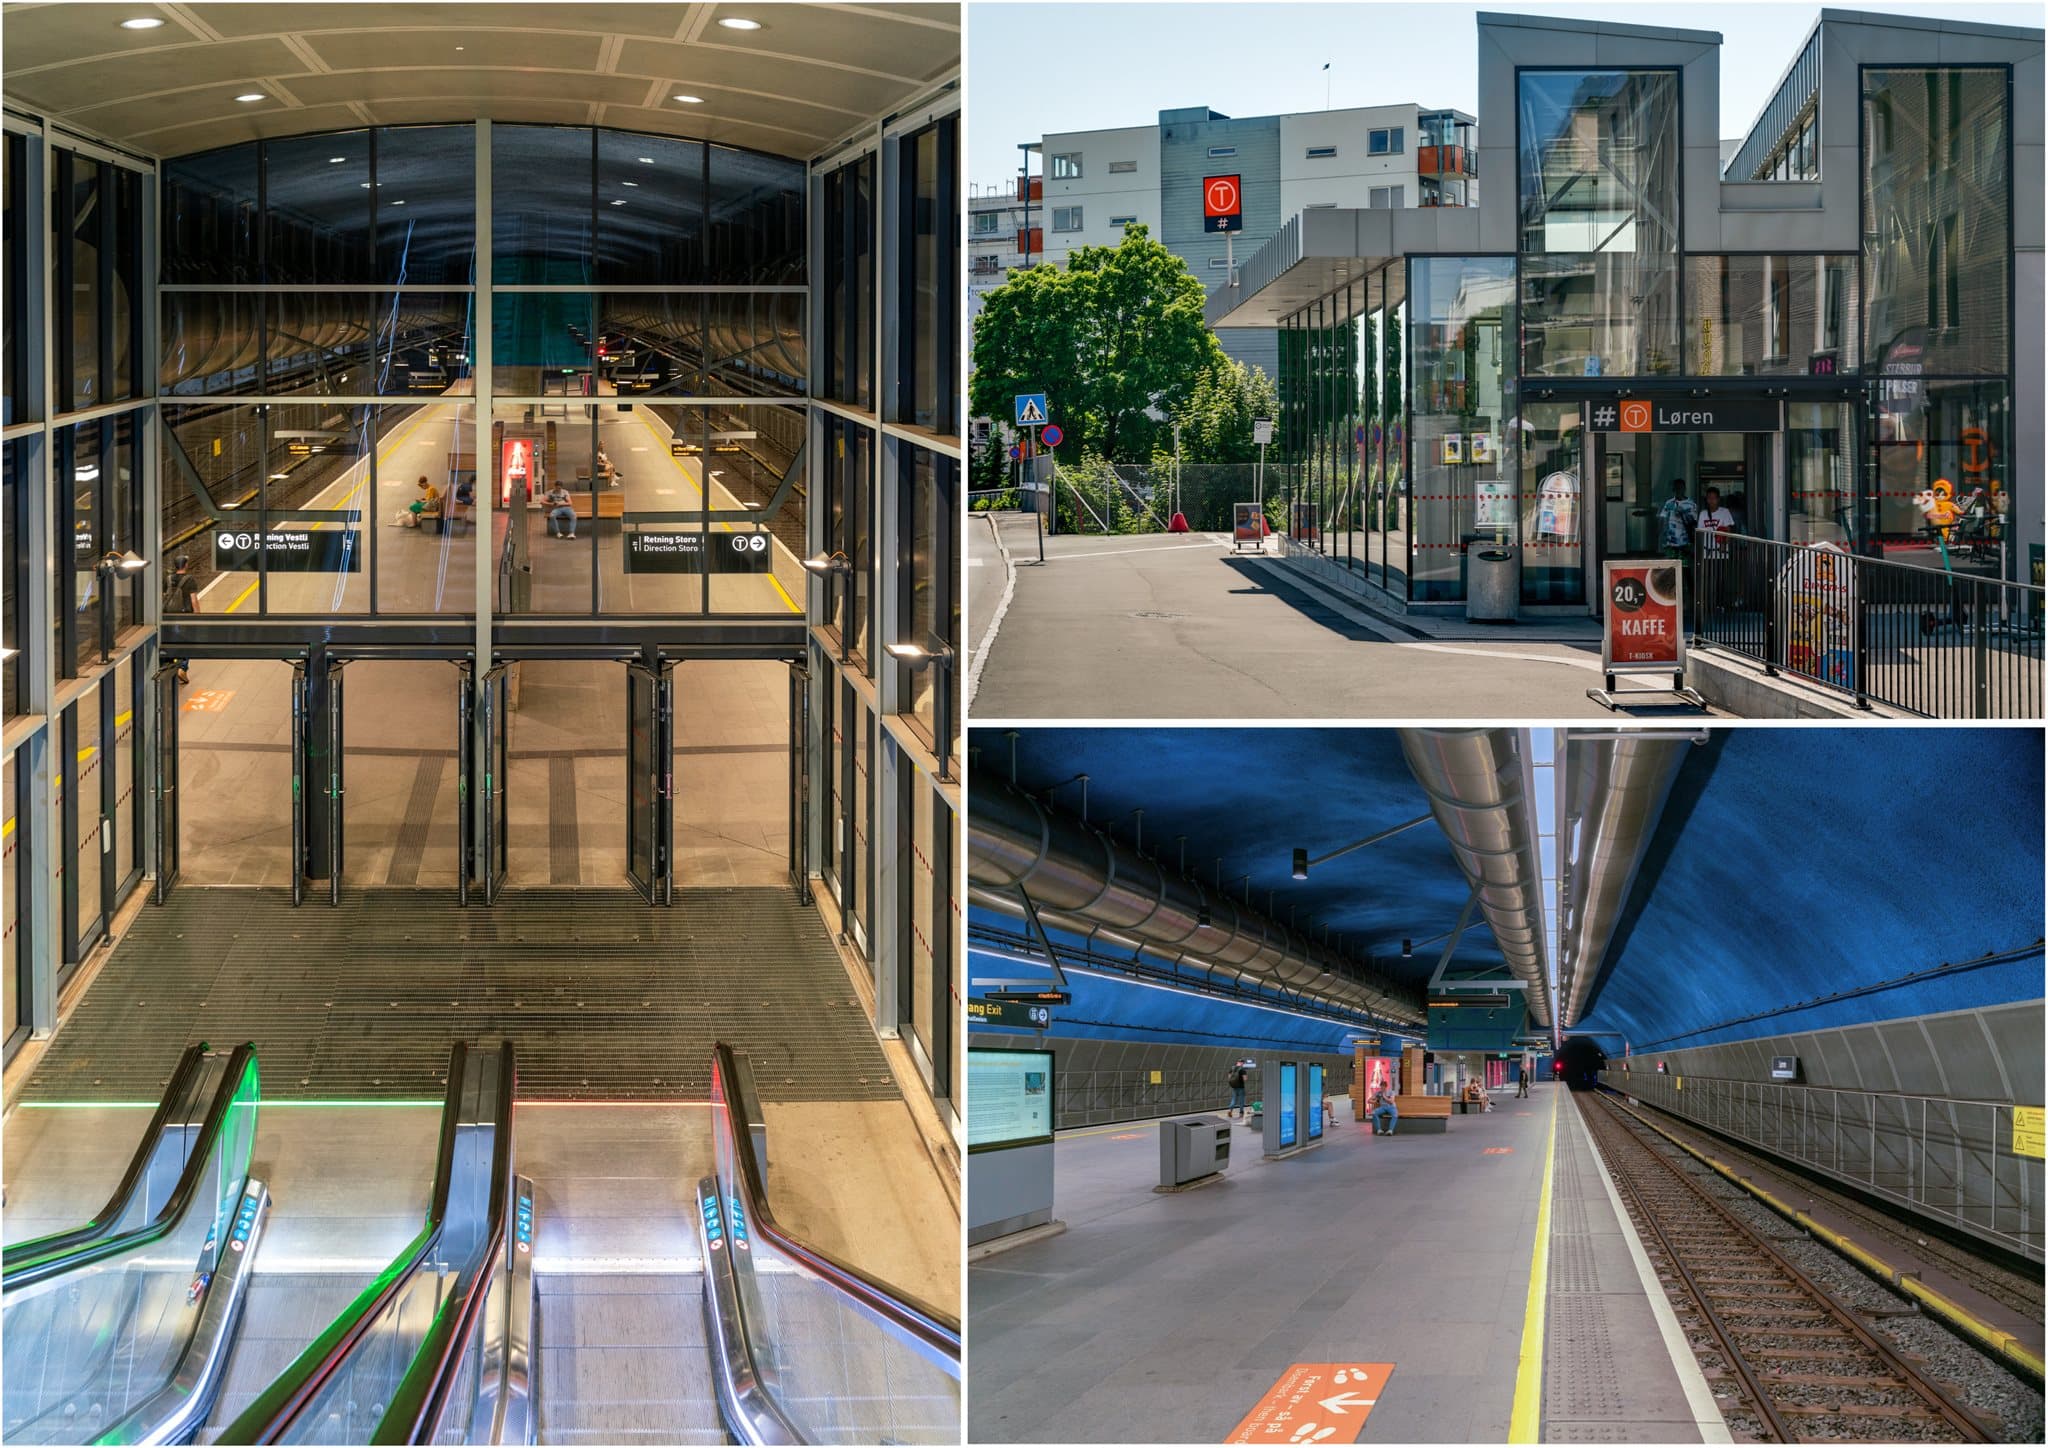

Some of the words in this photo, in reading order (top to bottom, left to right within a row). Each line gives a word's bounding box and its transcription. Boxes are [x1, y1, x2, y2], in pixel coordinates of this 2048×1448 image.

[1659, 408, 1713, 425] Løren
[254, 533, 284, 542] Rning
[285, 533, 308, 541] Vestli
[643, 536, 674, 544] Retning
[254, 542, 287, 550] Dction
[288, 542, 309, 550] Vestli
[643, 544, 677, 552] Direction
[1615, 586, 1644, 604] 20,-
[1622, 620, 1666, 636] KAFFE
[987, 1004, 1002, 1016] Exit
[1296, 1375, 1322, 1393] Først
[1289, 1394, 1304, 1403] av
[1275, 1411, 1293, 1421] så
[1264, 1423, 1284, 1433] på
